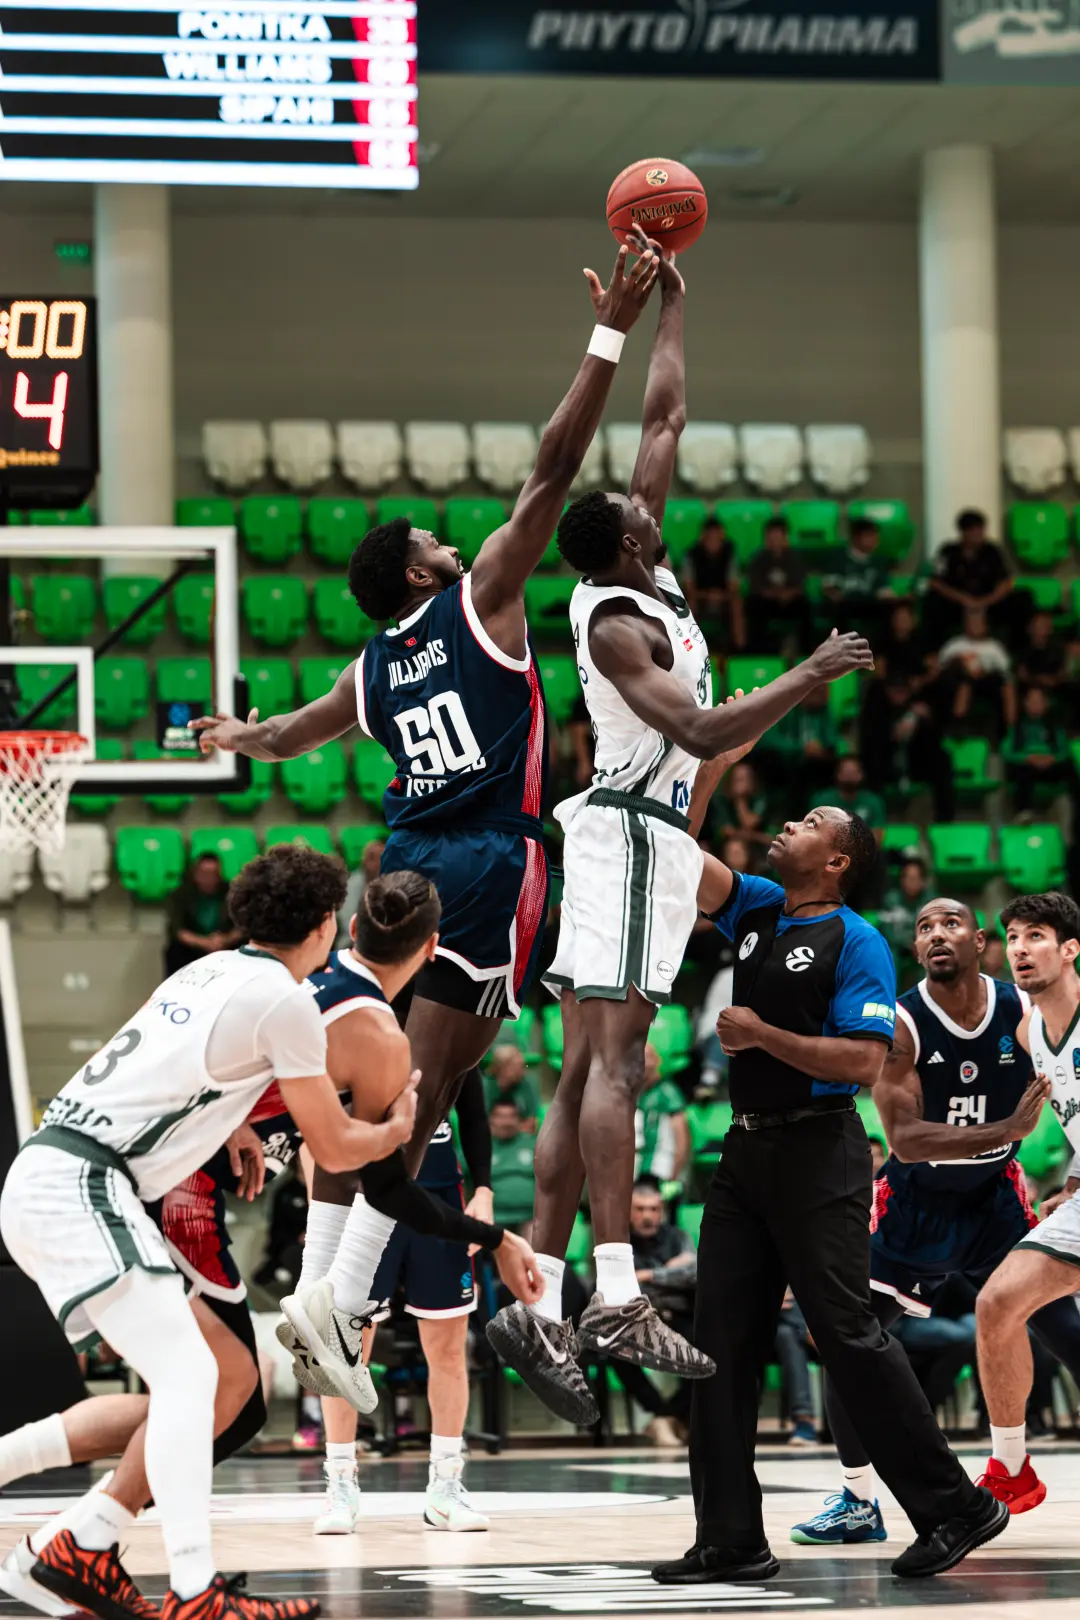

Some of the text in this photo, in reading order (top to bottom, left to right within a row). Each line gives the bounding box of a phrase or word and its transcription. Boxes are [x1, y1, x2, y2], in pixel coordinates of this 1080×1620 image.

[528, 11, 686, 50] PHYTO
[705, 14, 917, 54] PHARMA
[163, 52, 333, 83] WILLIAMS
[629, 196, 697, 224] SPALDING
[393, 690, 482, 776] 50
[947, 1094, 987, 1127] 24
